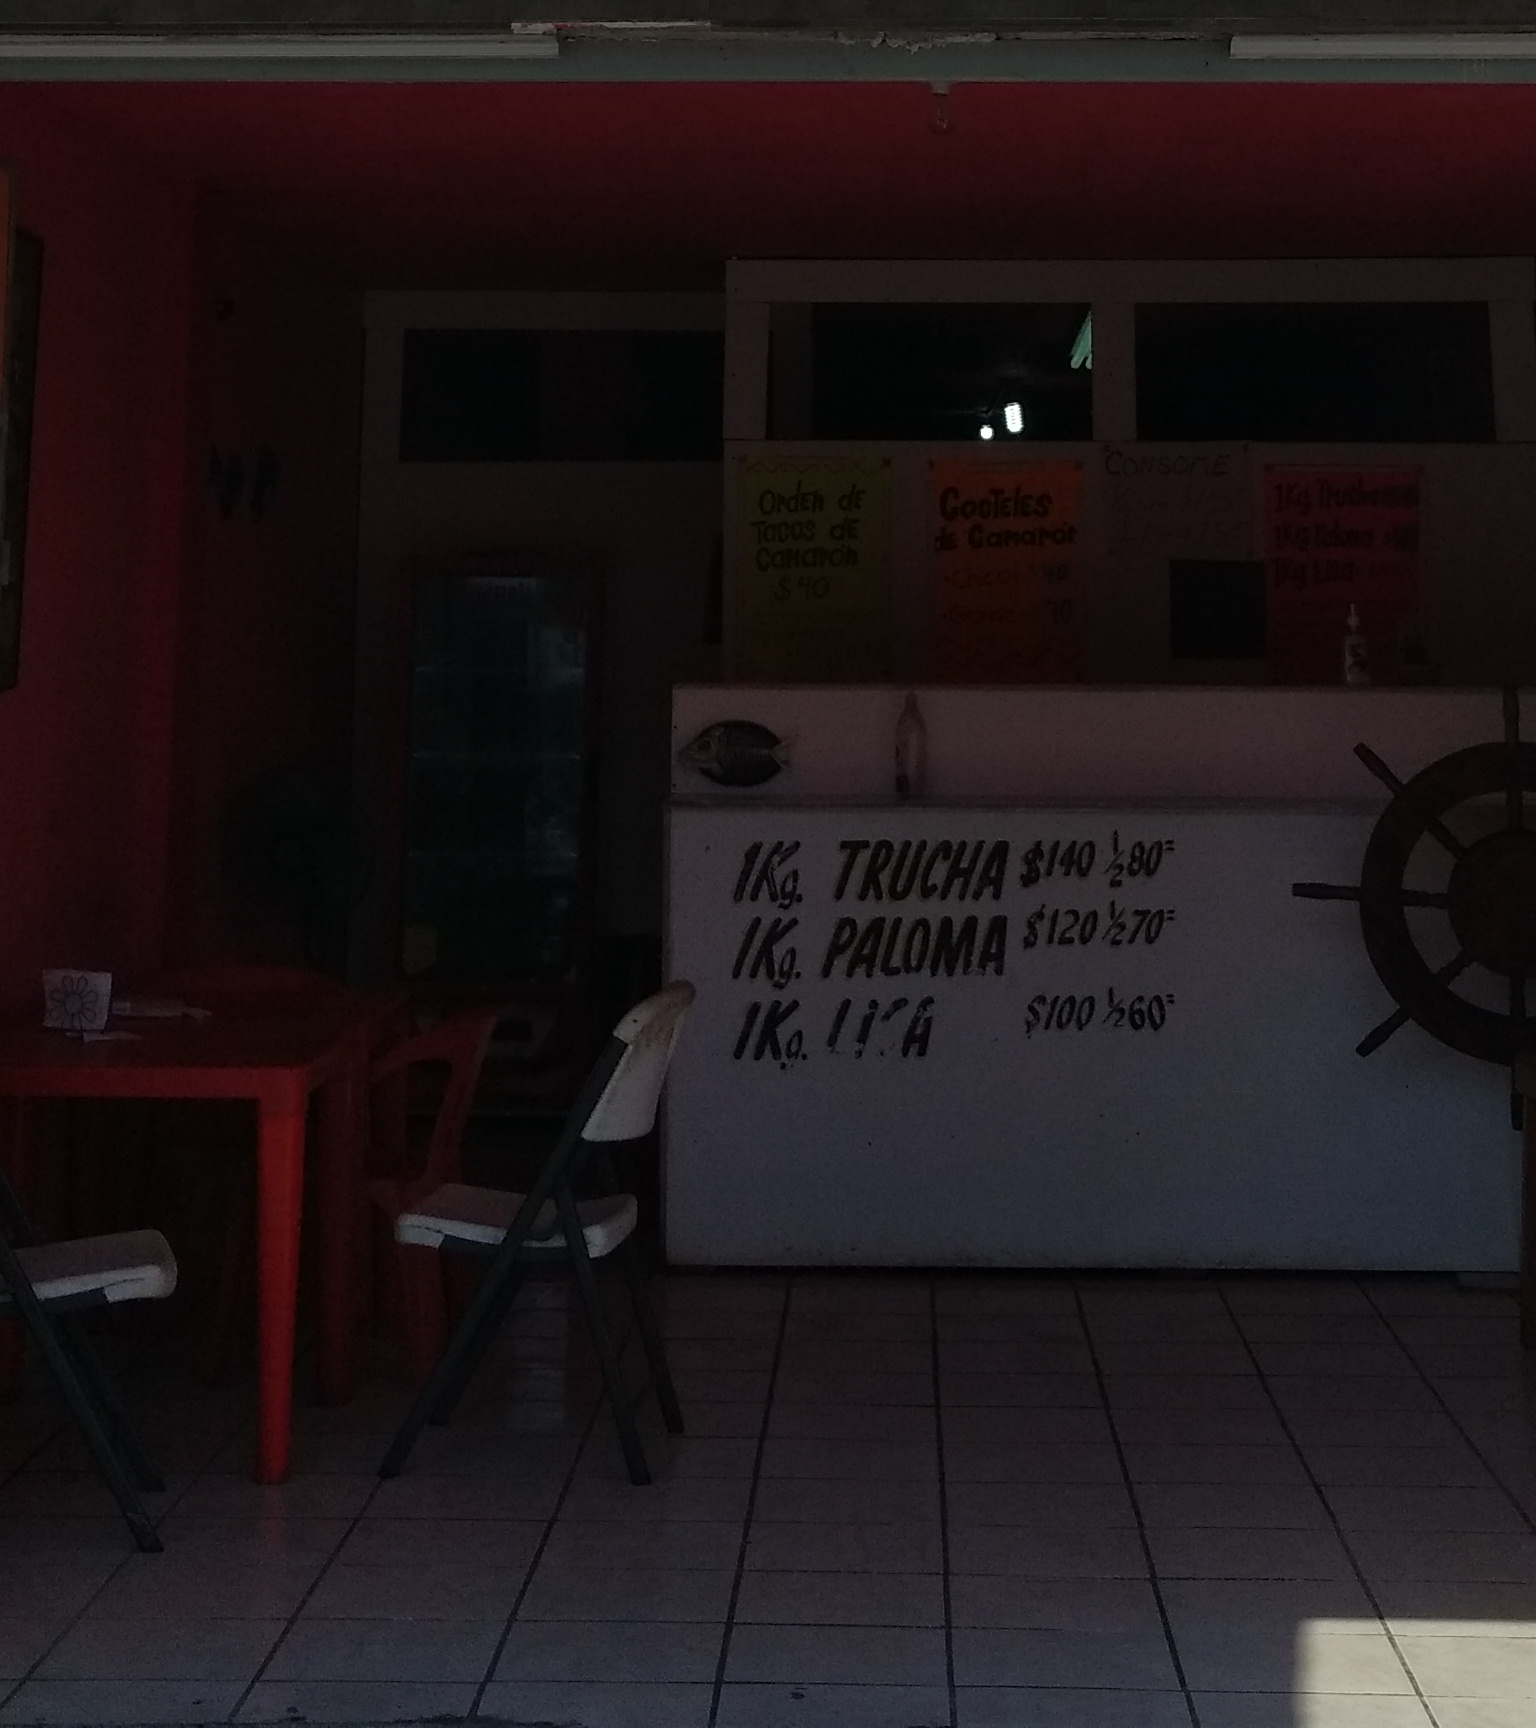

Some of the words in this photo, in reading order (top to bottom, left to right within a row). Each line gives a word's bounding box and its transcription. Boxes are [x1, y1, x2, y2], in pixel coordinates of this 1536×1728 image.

[833, 839, 1010, 901] TRUCHA
[1020, 839, 1096, 888] $140
[821, 914, 1008, 978] PALOMA
[1023, 904, 1098, 950] $120
[1025, 994, 1096, 1039] $100
